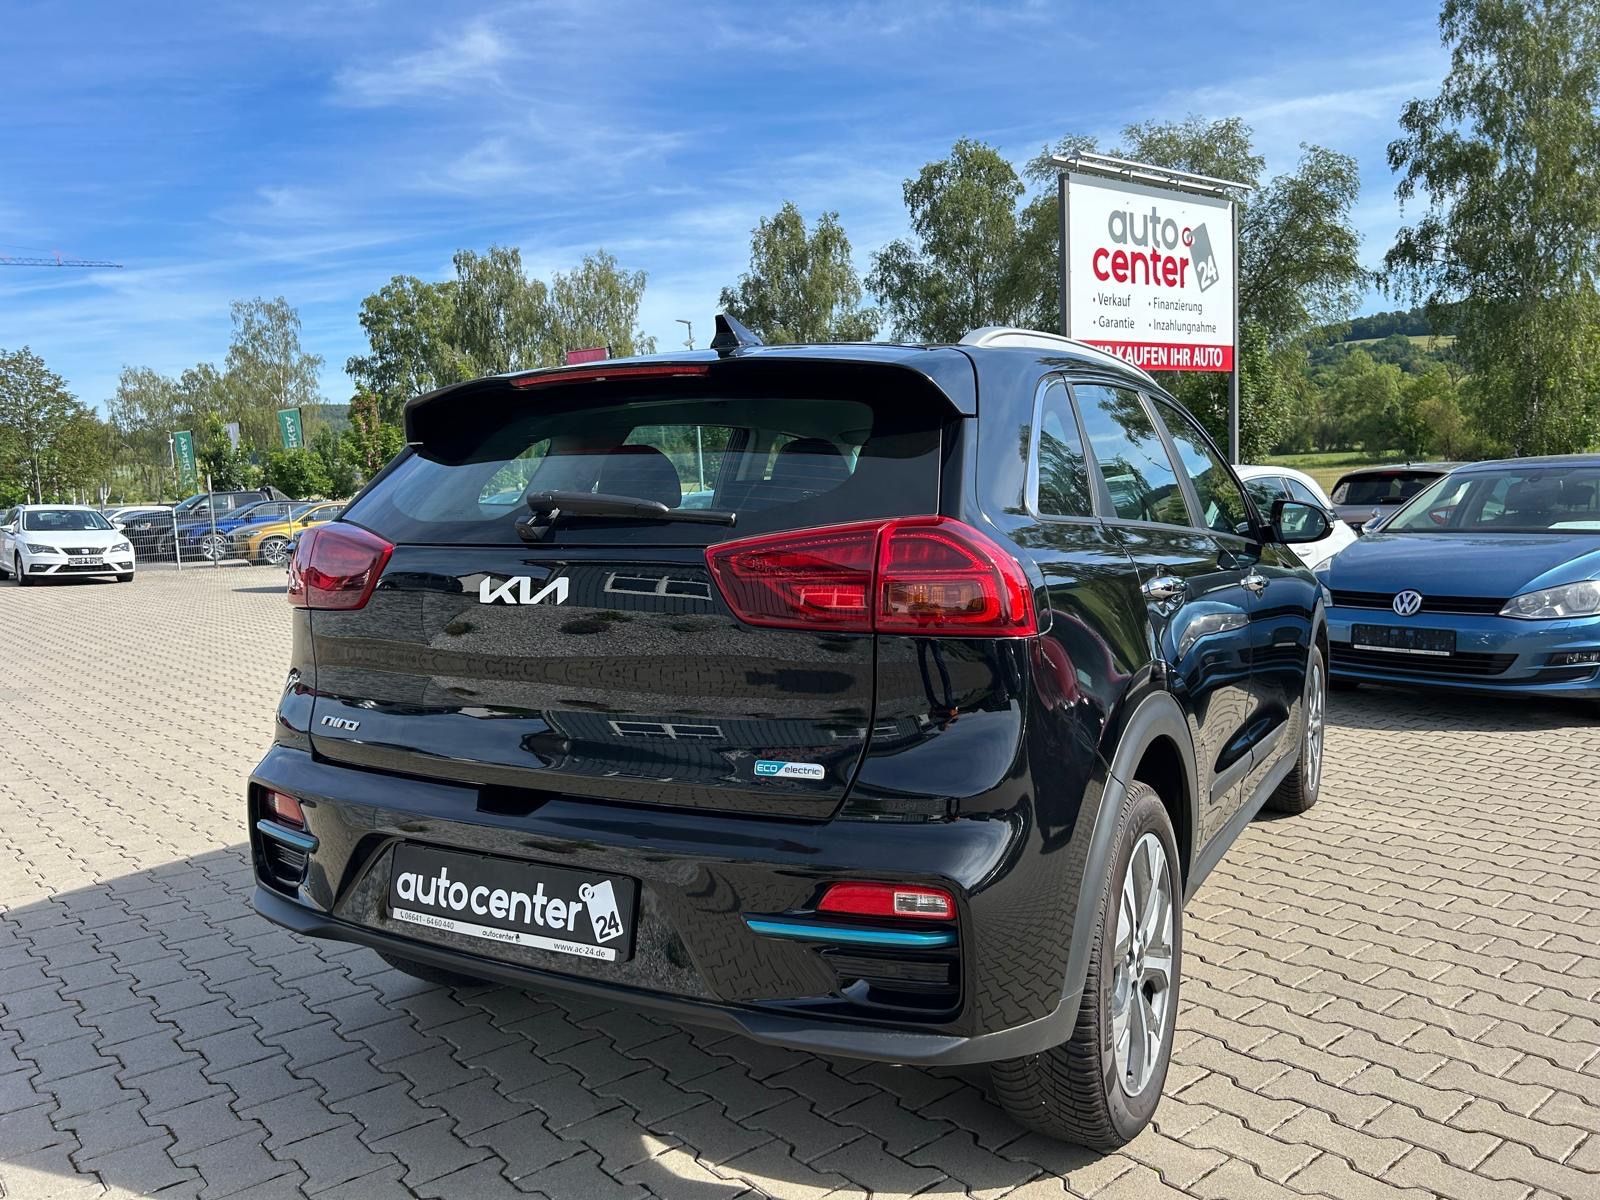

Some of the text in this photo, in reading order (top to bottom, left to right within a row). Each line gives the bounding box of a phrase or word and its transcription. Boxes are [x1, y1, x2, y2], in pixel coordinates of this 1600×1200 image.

[1108, 206, 1179, 250] auto
[1092, 246, 1189, 288] center
[1197, 255, 1217, 286] 24
[1098, 292, 1131, 307] Verkauf
[1153, 297, 1203, 315] Finanzierung
[1098, 315, 1135, 329] Garantie
[1153, 320, 1217, 335] Inzahlungnahme
[1116, 345, 1168, 366] KAUFEN
[1170, 347, 1191, 366] IHR
[1193, 347, 1223, 367] AUTO
[479, 576, 569, 605] KIA
[757, 764, 821, 776] ECO electric
[595, 911, 620, 939] 24
[553, 943, 606, 958] www.ac-24.de
